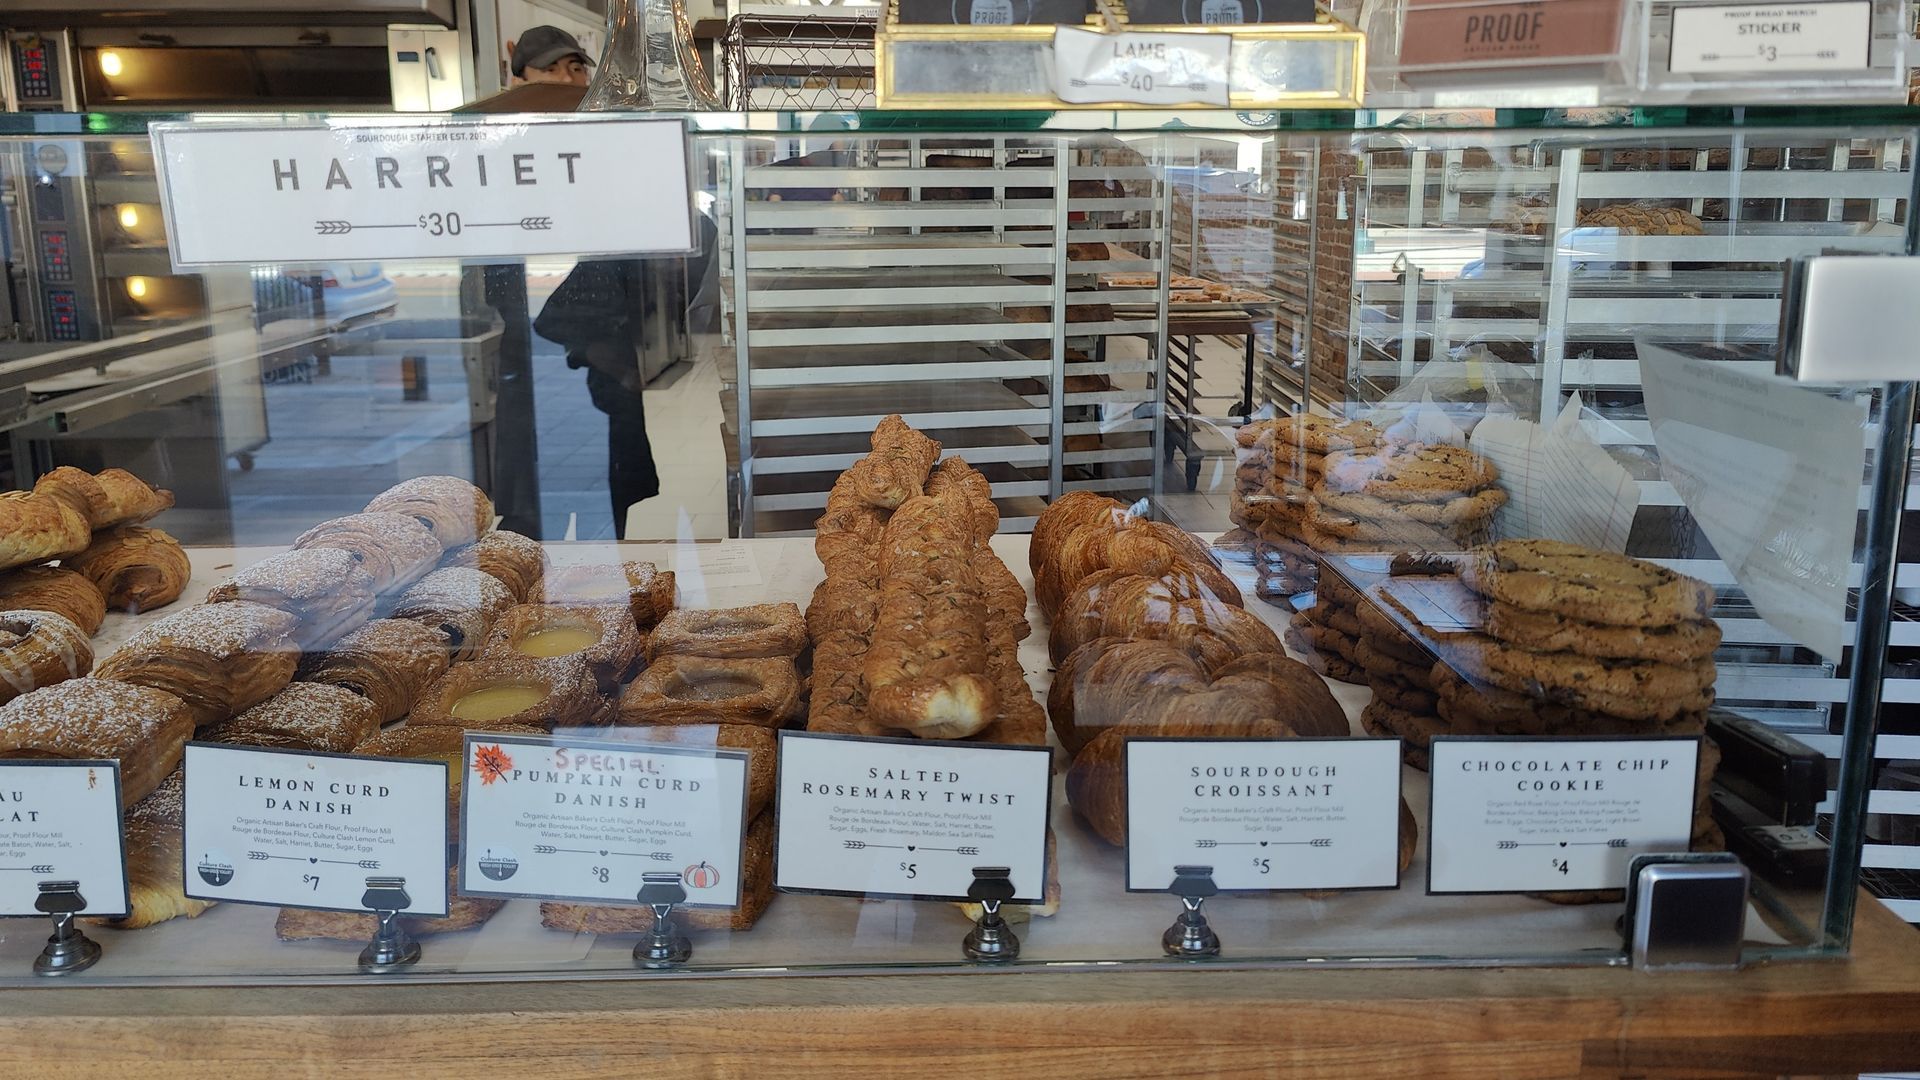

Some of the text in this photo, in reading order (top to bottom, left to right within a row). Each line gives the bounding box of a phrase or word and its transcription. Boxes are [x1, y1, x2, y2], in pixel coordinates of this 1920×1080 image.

[975, 11, 1009, 24] PROOF
[1465, 12, 1545, 43] PROOF
[1738, 23, 1801, 35] STICKER
[1113, 42, 1166, 59] LAME
[1758, 45, 1777, 62] $3
[1121, 72, 1153, 92] $40
[356, 134, 408, 143] SOURDOUGH
[410, 132, 448, 142] STARTER
[450, 132, 468, 141] EST.
[272, 152, 582, 191] HARRIET
[418, 212, 462, 236] $30
[1190, 766, 1336, 777] SOURDOUGH
[1462, 759, 1669, 772] CHOCOLATE CHIP
[512, 769, 700, 792] PUMPKIN CURD
[868, 767, 960, 783] SALTED
[239, 775, 390, 797] LEMON CURD
[802, 782, 1015, 806] ROSEMARY TWIST
[1194, 784, 1333, 797] CROISSANT
[1517, 780, 1604, 791] COOKIE
[265, 798, 352, 815] DANISH
[554, 792, 647, 809] DANISH
[236, 816, 392, 835] Organic Artisan Baker's Craft Flour, Proof Flour Mill
[522, 812, 549, 820] Organic
[574, 815, 598, 823] Baker's
[600, 816, 616, 824] Craft
[617, 817, 635, 825] Flour,
[637, 818, 655, 826] Proof
[656, 819, 673, 827] Flour
[232, 824, 252, 834] Rouge
[263, 828, 292, 836] Bordeaux
[293, 830, 311, 839] Flour,
[312, 831, 335, 840] Culture
[336, 833, 354, 841] Clash
[355, 835, 376, 843] Lemon
[378, 836, 395, 845] Curd,
[515, 820, 536, 829] Rouge
[548, 822, 579, 830] Bordeaux
[580, 824, 599, 832] Flour,
[600, 825, 625, 833] Culture
[626, 826, 644, 834] Clash
[645, 828, 673, 836] Pumpkin
[674, 829, 692, 838] Curd,
[12, 841, 32, 849] Baton,
[35, 841, 56, 849] Water,
[58, 841, 72, 849] Salt,
[253, 836, 373, 853] Water, Salt, Harriet, Butter, Sugar, Eggs
[541, 831, 667, 845] Water, Salt, Harriet, Butter, Sugar, Eggs
[10, 850, 26, 858] Eggs
[899, 862, 917, 879] $5
[1252, 857, 1270, 874] $5
[1552, 858, 1569, 875] $4
[303, 874, 320, 891] $7
[591, 866, 610, 883] $8
